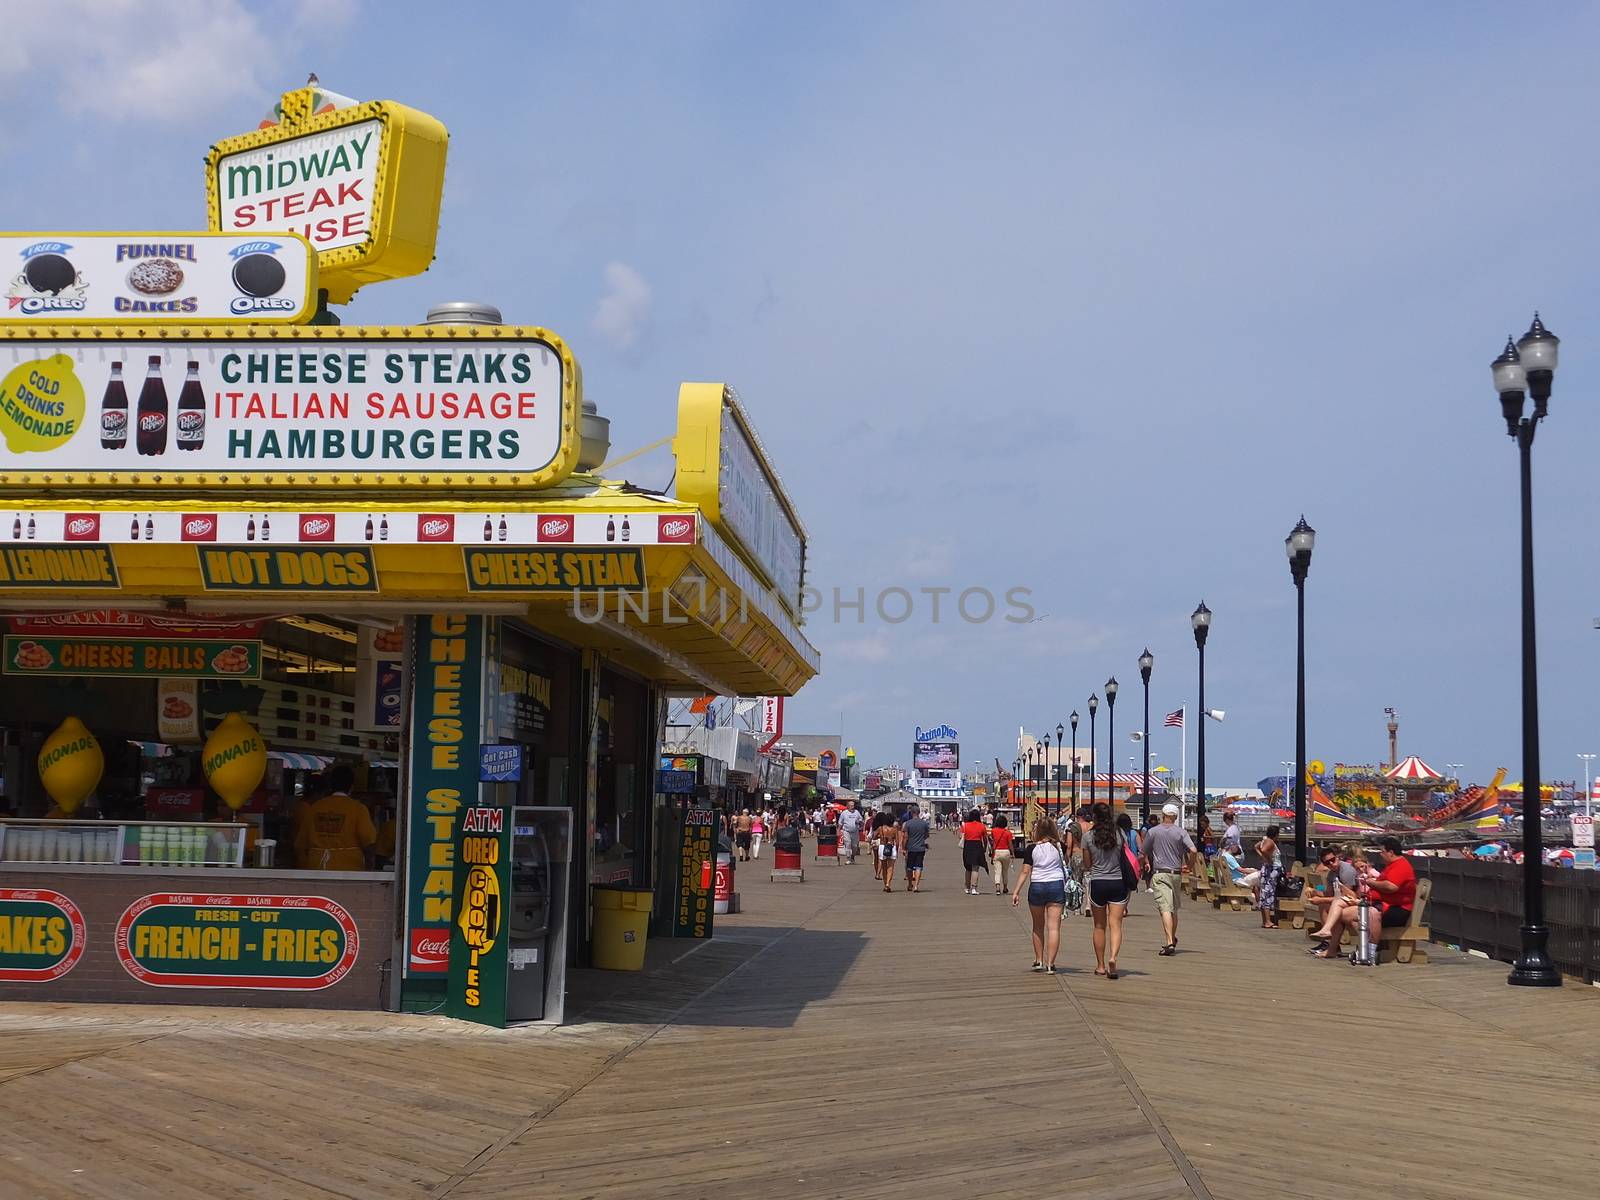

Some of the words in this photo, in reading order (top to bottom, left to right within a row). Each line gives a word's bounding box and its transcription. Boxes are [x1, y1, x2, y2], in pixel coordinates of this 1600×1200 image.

[233, 178, 364, 228] STEAK
[26, 242, 62, 255] FRIED
[116, 244, 197, 262] FUNNEL
[236, 241, 272, 254] FRIED
[22, 297, 85, 313] OREO
[114, 297, 198, 313] CAKES
[231, 297, 295, 314] OREO
[221, 354, 366, 384] CHEESE
[384, 354, 531, 384] STEAKS
[29, 370, 60, 394] COLD
[16, 384, 64, 417] DRINKS
[214, 392, 349, 419] ITALIAN
[366, 392, 536, 419] SAUSAGE
[0, 390, 75, 437] LEMONADE
[227, 429, 520, 459] HAMBURGERS
[70, 521, 93, 534] Pepper
[188, 522, 211, 535] Pepper
[305, 522, 329, 535] Pepper
[424, 523, 448, 536] Pepper
[544, 523, 567, 536] Pepper
[664, 523, 687, 536] Pepper
[8, 548, 112, 581] LEMONADE
[206, 551, 270, 585] HOT
[277, 552, 370, 586] DOGS
[470, 552, 560, 586] CHEESE
[562, 552, 640, 586] STEAK
[60, 643, 134, 668] CHEESE
[144, 645, 205, 670] BALLS
[428, 614, 466, 770] CHEESE
[765, 700, 774, 733] PIZZA
[915, 726, 941, 742] Casino
[941, 724, 958, 739] Pier
[40, 737, 94, 773] MONADE
[206, 738, 258, 778] MONADE
[484, 753, 497, 763] Get
[498, 748, 518, 760] Cash
[463, 808, 503, 832] ATM
[685, 809, 714, 825] ATM
[422, 788, 461, 922] STEAK
[463, 837, 499, 864] OREO
[680, 827, 693, 926] HAMBURGERS
[169, 895, 193, 904] DASANI
[206, 896, 233, 905] Coca-Cola
[247, 897, 271, 905] DASANI
[282, 898, 309, 906] Coca-Cola
[195, 909, 239, 922] FRESH
[251, 911, 280, 922] CUT
[325, 902, 347, 922] DASANI
[694, 888, 708, 938] DOGS
[135, 924, 240, 961] FRENCH
[262, 928, 338, 964] FRIES
[417, 938, 449, 956] Coca-C
[465, 869, 488, 1007] COOKIES
